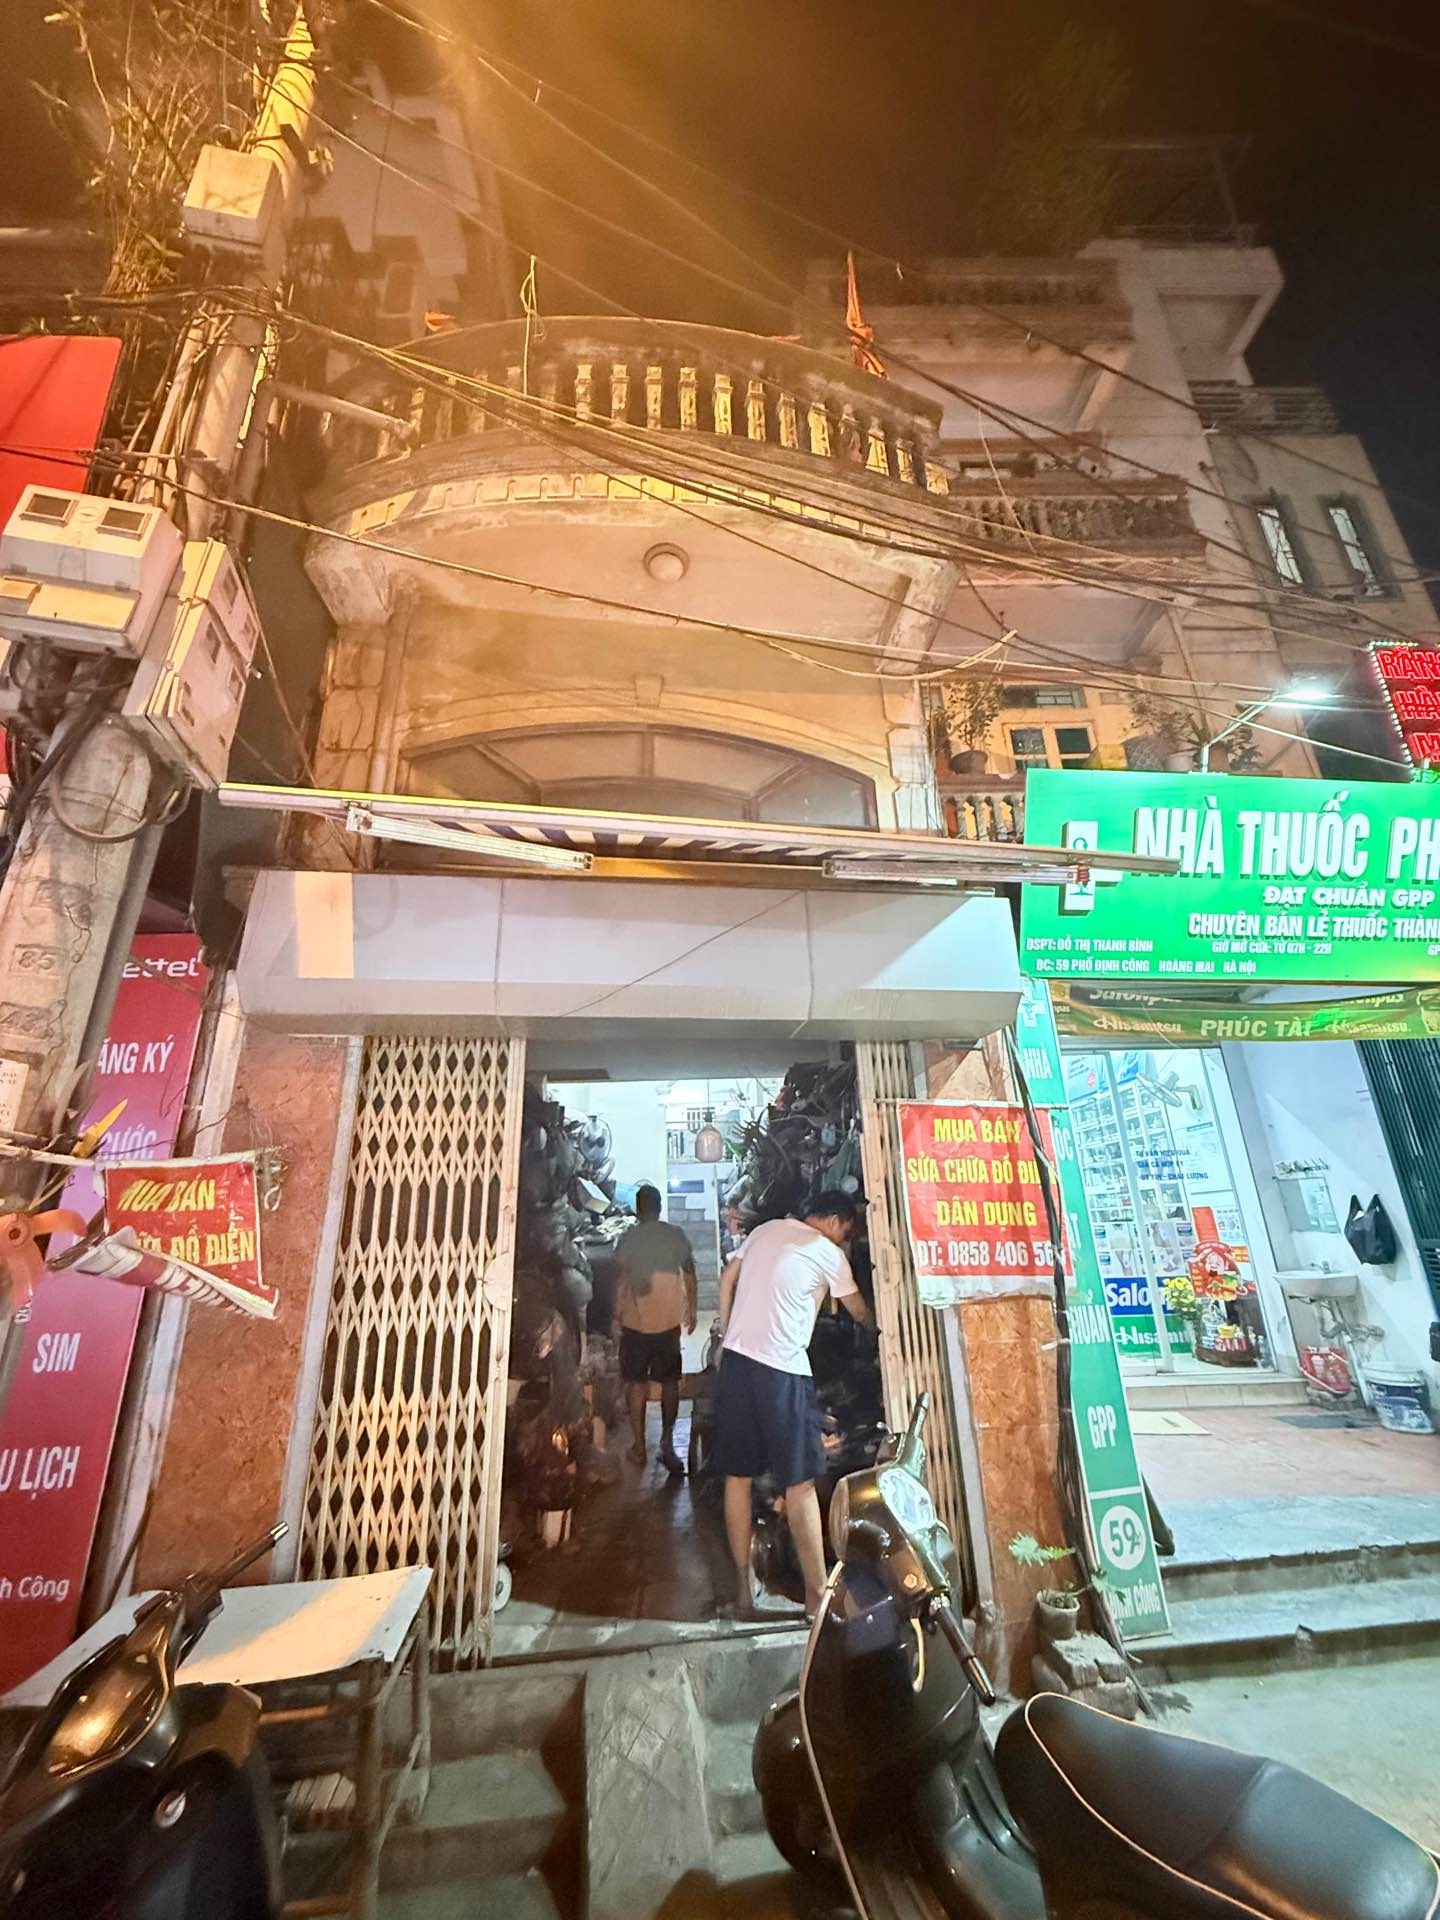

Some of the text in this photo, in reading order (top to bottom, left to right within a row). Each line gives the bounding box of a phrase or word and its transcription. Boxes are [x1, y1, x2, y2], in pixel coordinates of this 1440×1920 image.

[1135, 796, 1225, 876] NHÀ
[1237, 790, 1371, 878] THUỐC
[1263, 882, 1436, 909] ĐẠT CHUẨN GPP
[1188, 910, 1260, 937] CHUYÊN
[1332, 911, 1388, 938] THUỐC
[1073, 938, 1091, 954] THỊ
[1093, 939, 1126, 952] THANH
[1055, 959, 1070, 972] 59
[1121, 957, 1150, 972] CÔNG
[1158, 958, 1193, 973] HOÀNG
[1195, 960, 1215, 973] MAI
[1223, 959, 1237, 973] HÀ
[1238, 959, 1257, 976] NỘI
[1200, 1015, 1268, 1037] PHÚC
[142, 1035, 174, 1074] KÝ
[934, 1118, 978, 1142] MUA
[980, 1115, 1022, 1143] BÁN
[907, 1151, 940, 1183] SỬA
[944, 1155, 989, 1184] CHỮA
[936, 1196, 979, 1227] DÂN
[982, 1201, 1038, 1232] DỤNG
[949, 1240, 990, 1267] 0858
[995, 1240, 1029, 1267] 406
[32, 1332, 81, 1373] SIM
[1087, 1404, 1117, 1449] GPP
[19, 1446, 81, 1499] LỊCH
[18, 1576, 70, 1602] Công
